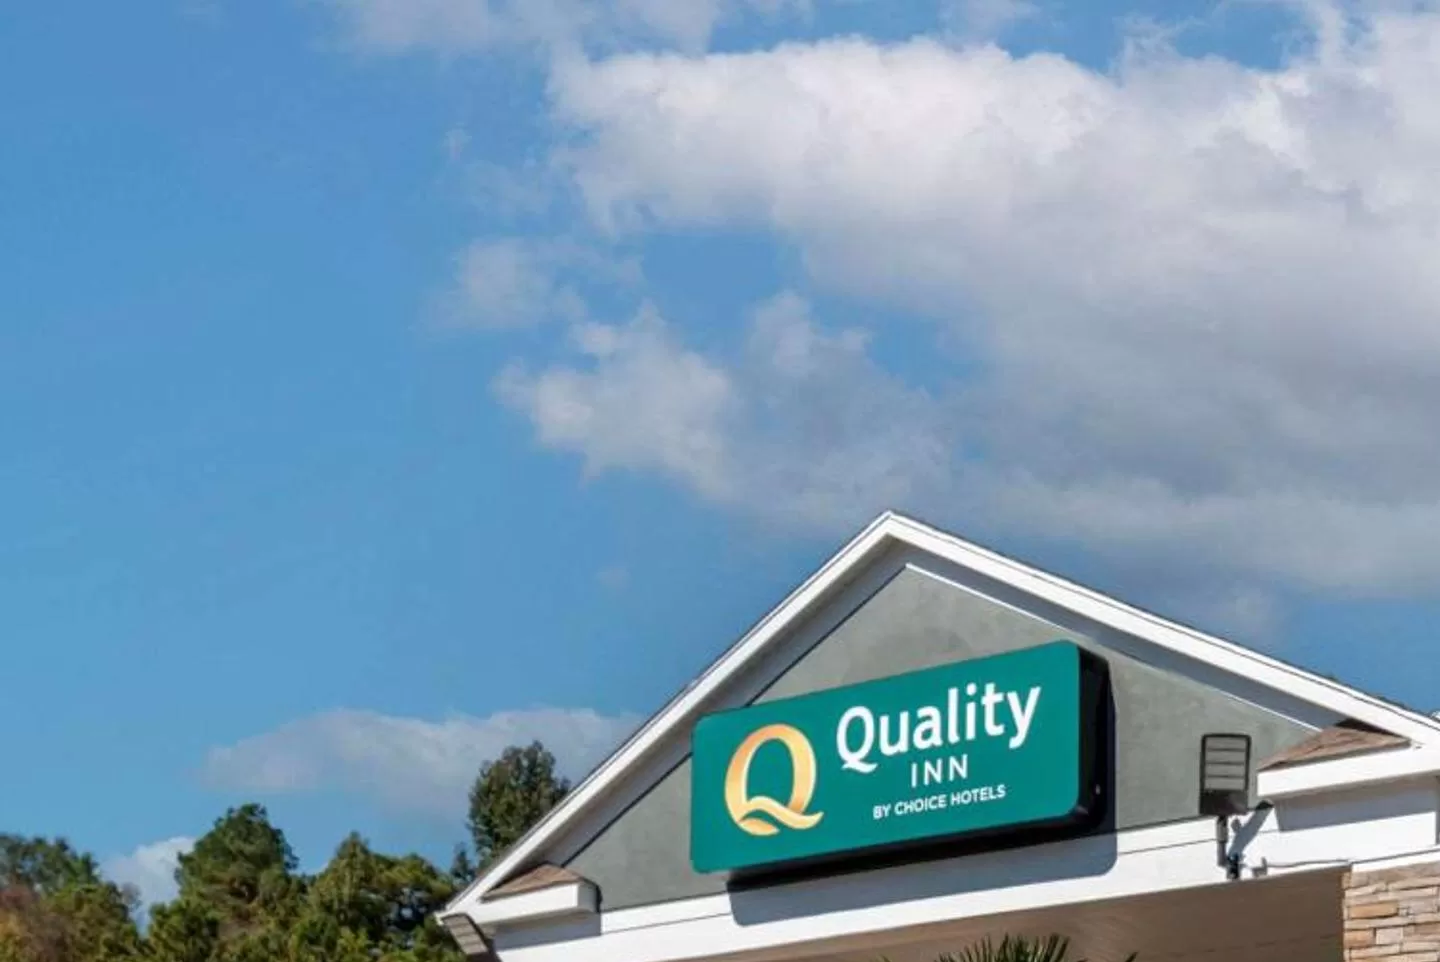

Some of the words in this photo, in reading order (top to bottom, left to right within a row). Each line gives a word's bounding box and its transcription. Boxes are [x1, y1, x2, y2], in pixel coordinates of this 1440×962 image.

[836, 682, 1041, 774] Quality
[724, 723, 824, 836] Q
[872, 802, 892, 820] BY
[894, 794, 947, 815] CHOICE
[950, 784, 1006, 806] HOTELS
[910, 753, 968, 788] INN
